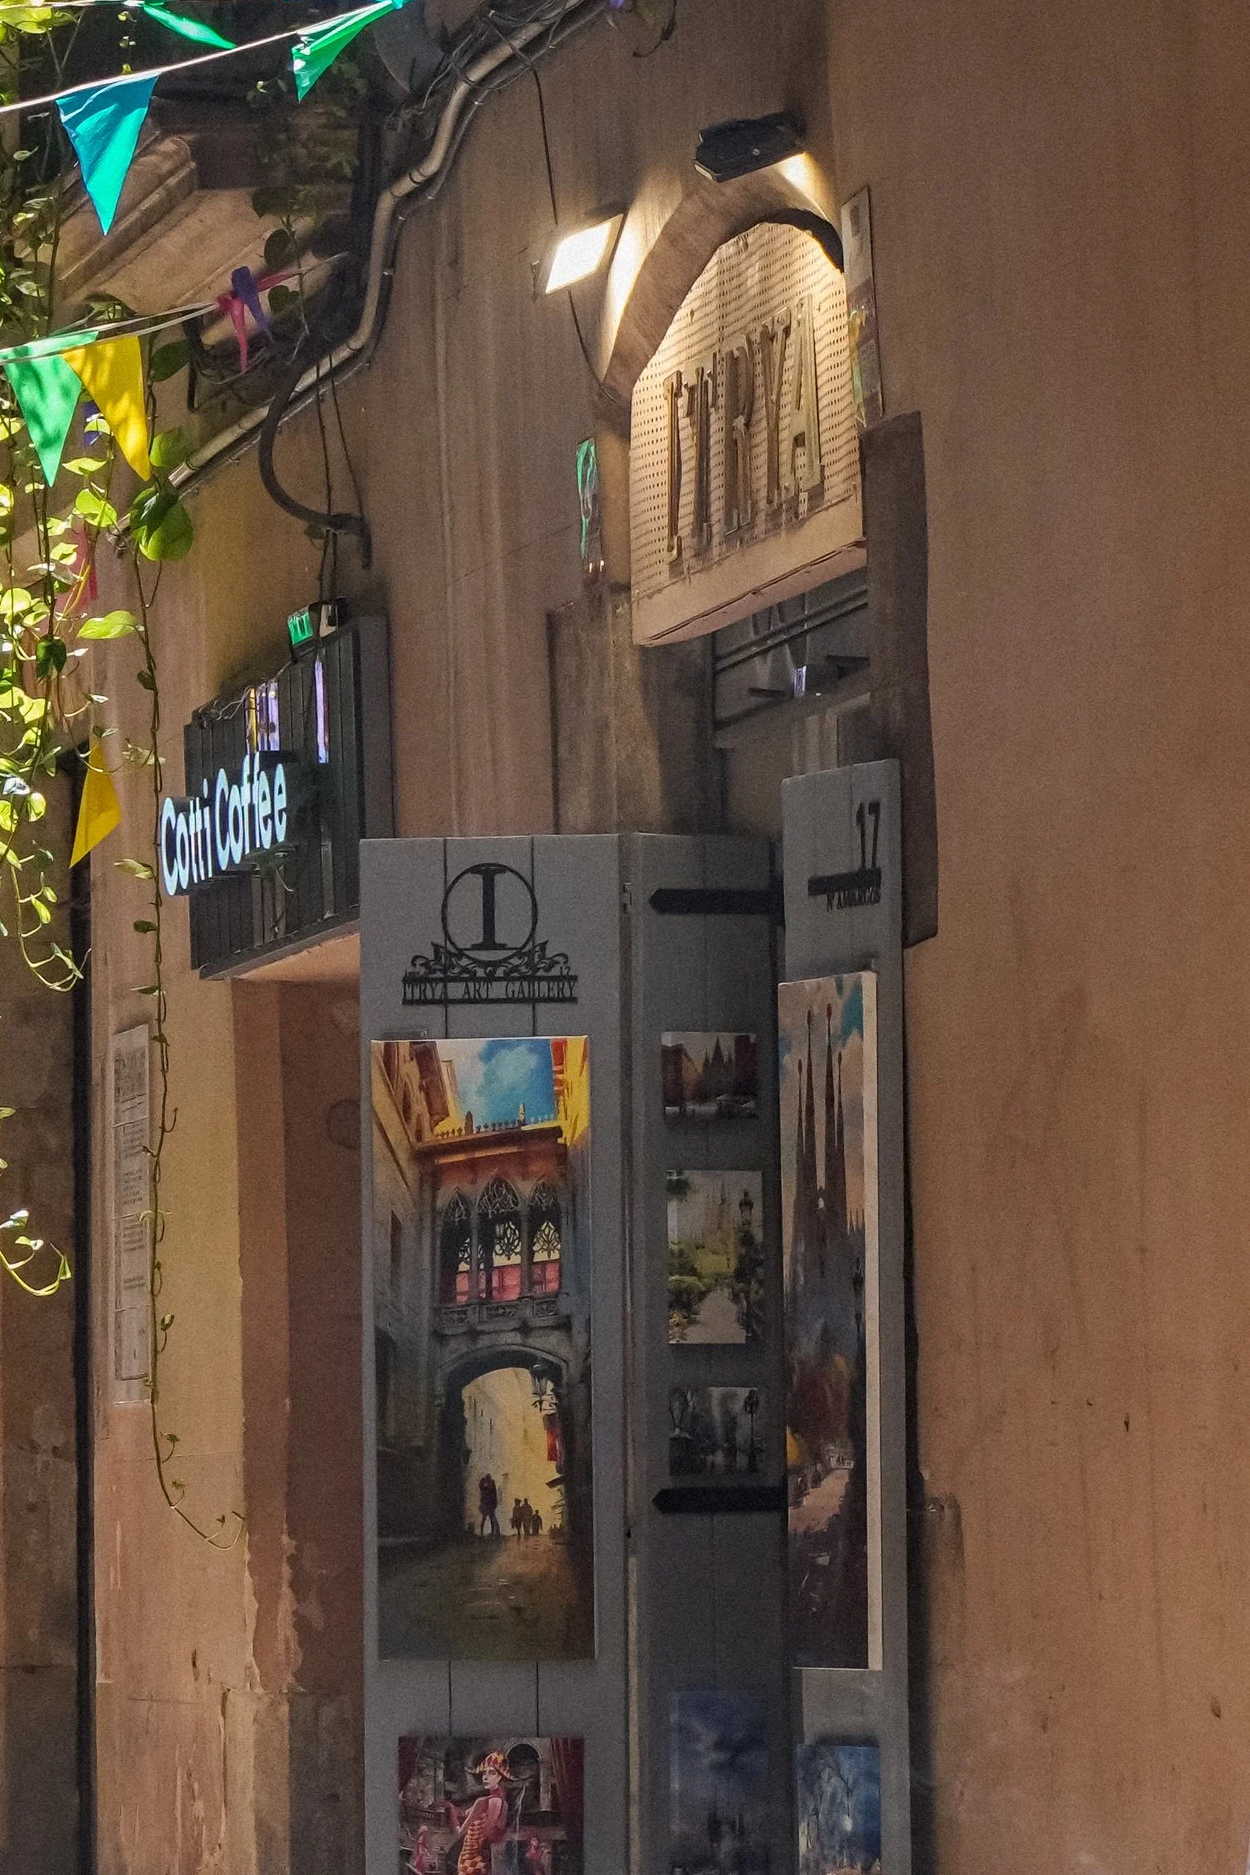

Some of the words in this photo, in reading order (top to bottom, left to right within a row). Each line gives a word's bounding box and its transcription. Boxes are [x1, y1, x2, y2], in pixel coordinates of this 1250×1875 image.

[663, 293, 823, 565] ITRYA
[161, 778, 213, 896] Cotti
[215, 751, 287, 871] Coffee
[856, 801, 881, 869] 17
[462, 979, 493, 1001] ART
[505, 978, 577, 1001] GALLERY
